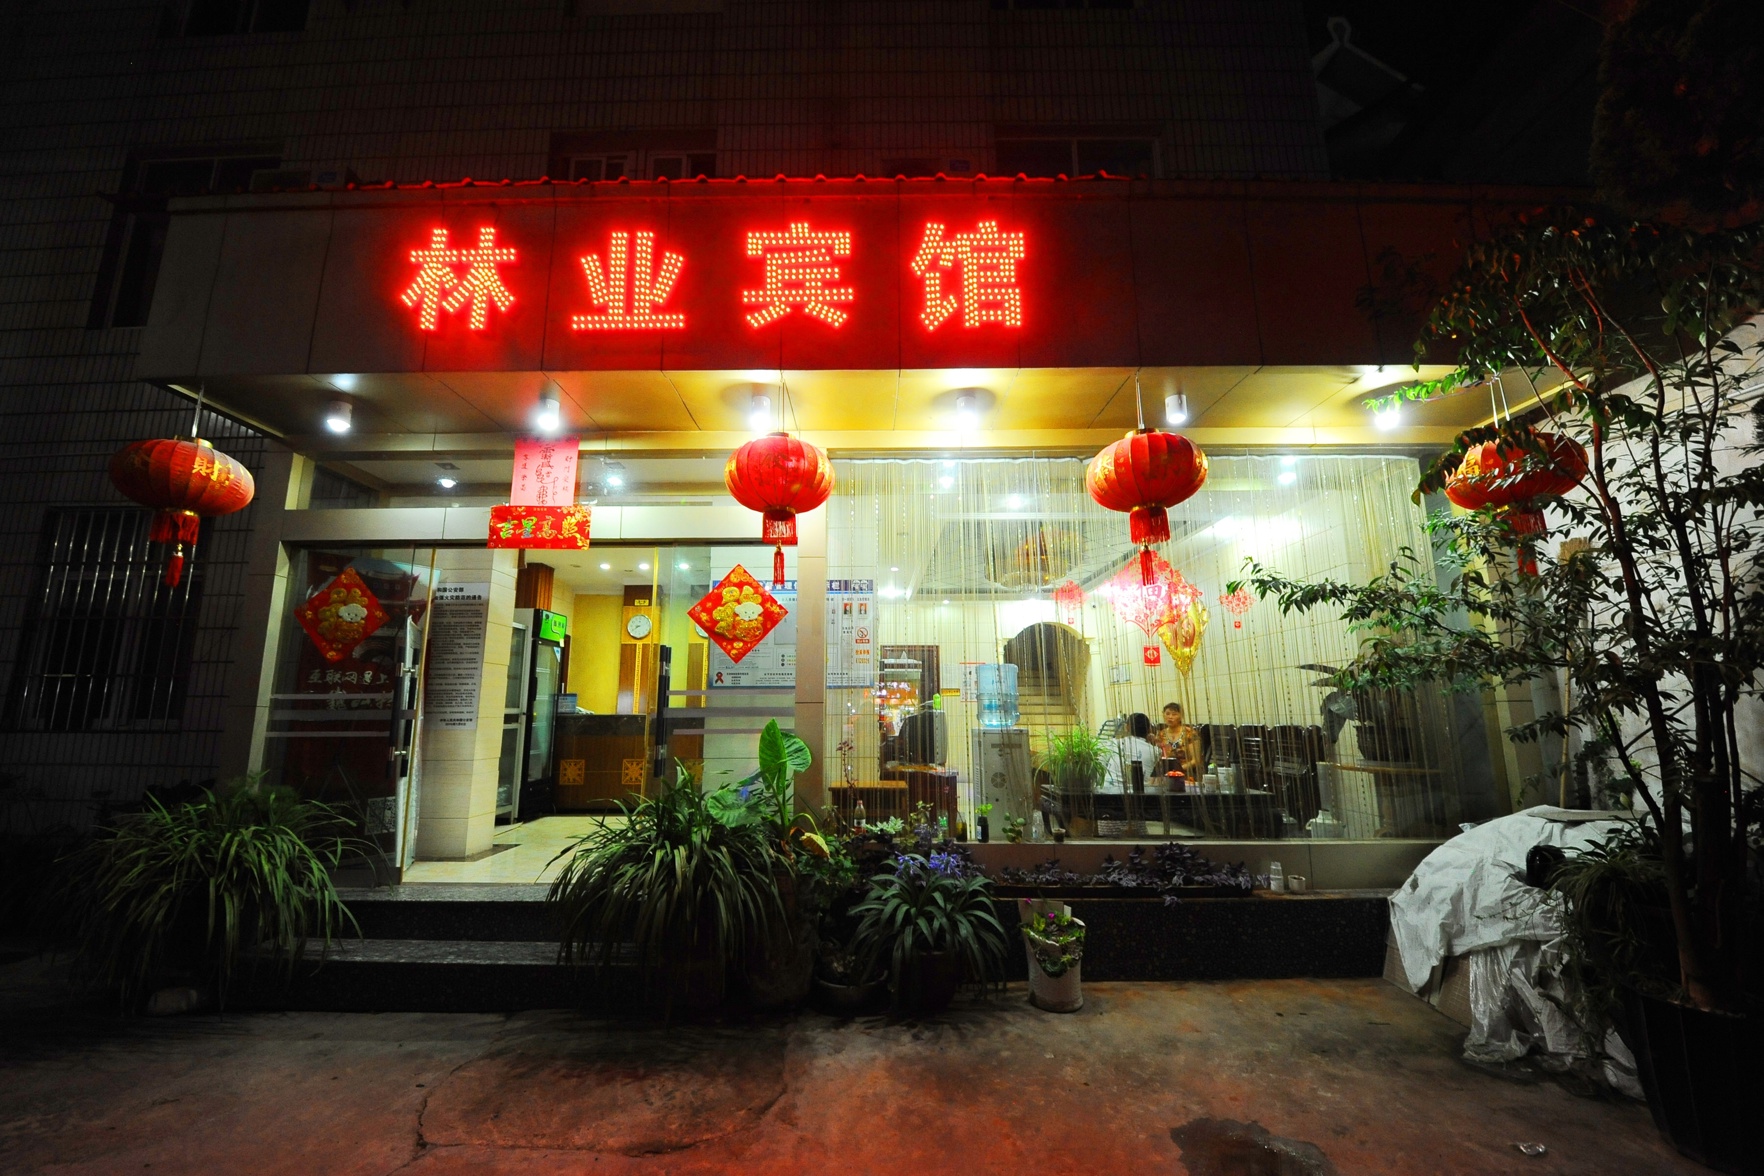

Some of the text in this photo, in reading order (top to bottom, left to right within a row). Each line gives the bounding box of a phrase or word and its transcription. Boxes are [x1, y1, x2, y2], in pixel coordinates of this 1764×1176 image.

[401, 221, 1025, 330] 林业宾馆
[496, 515, 571, 539] 吉星高照
